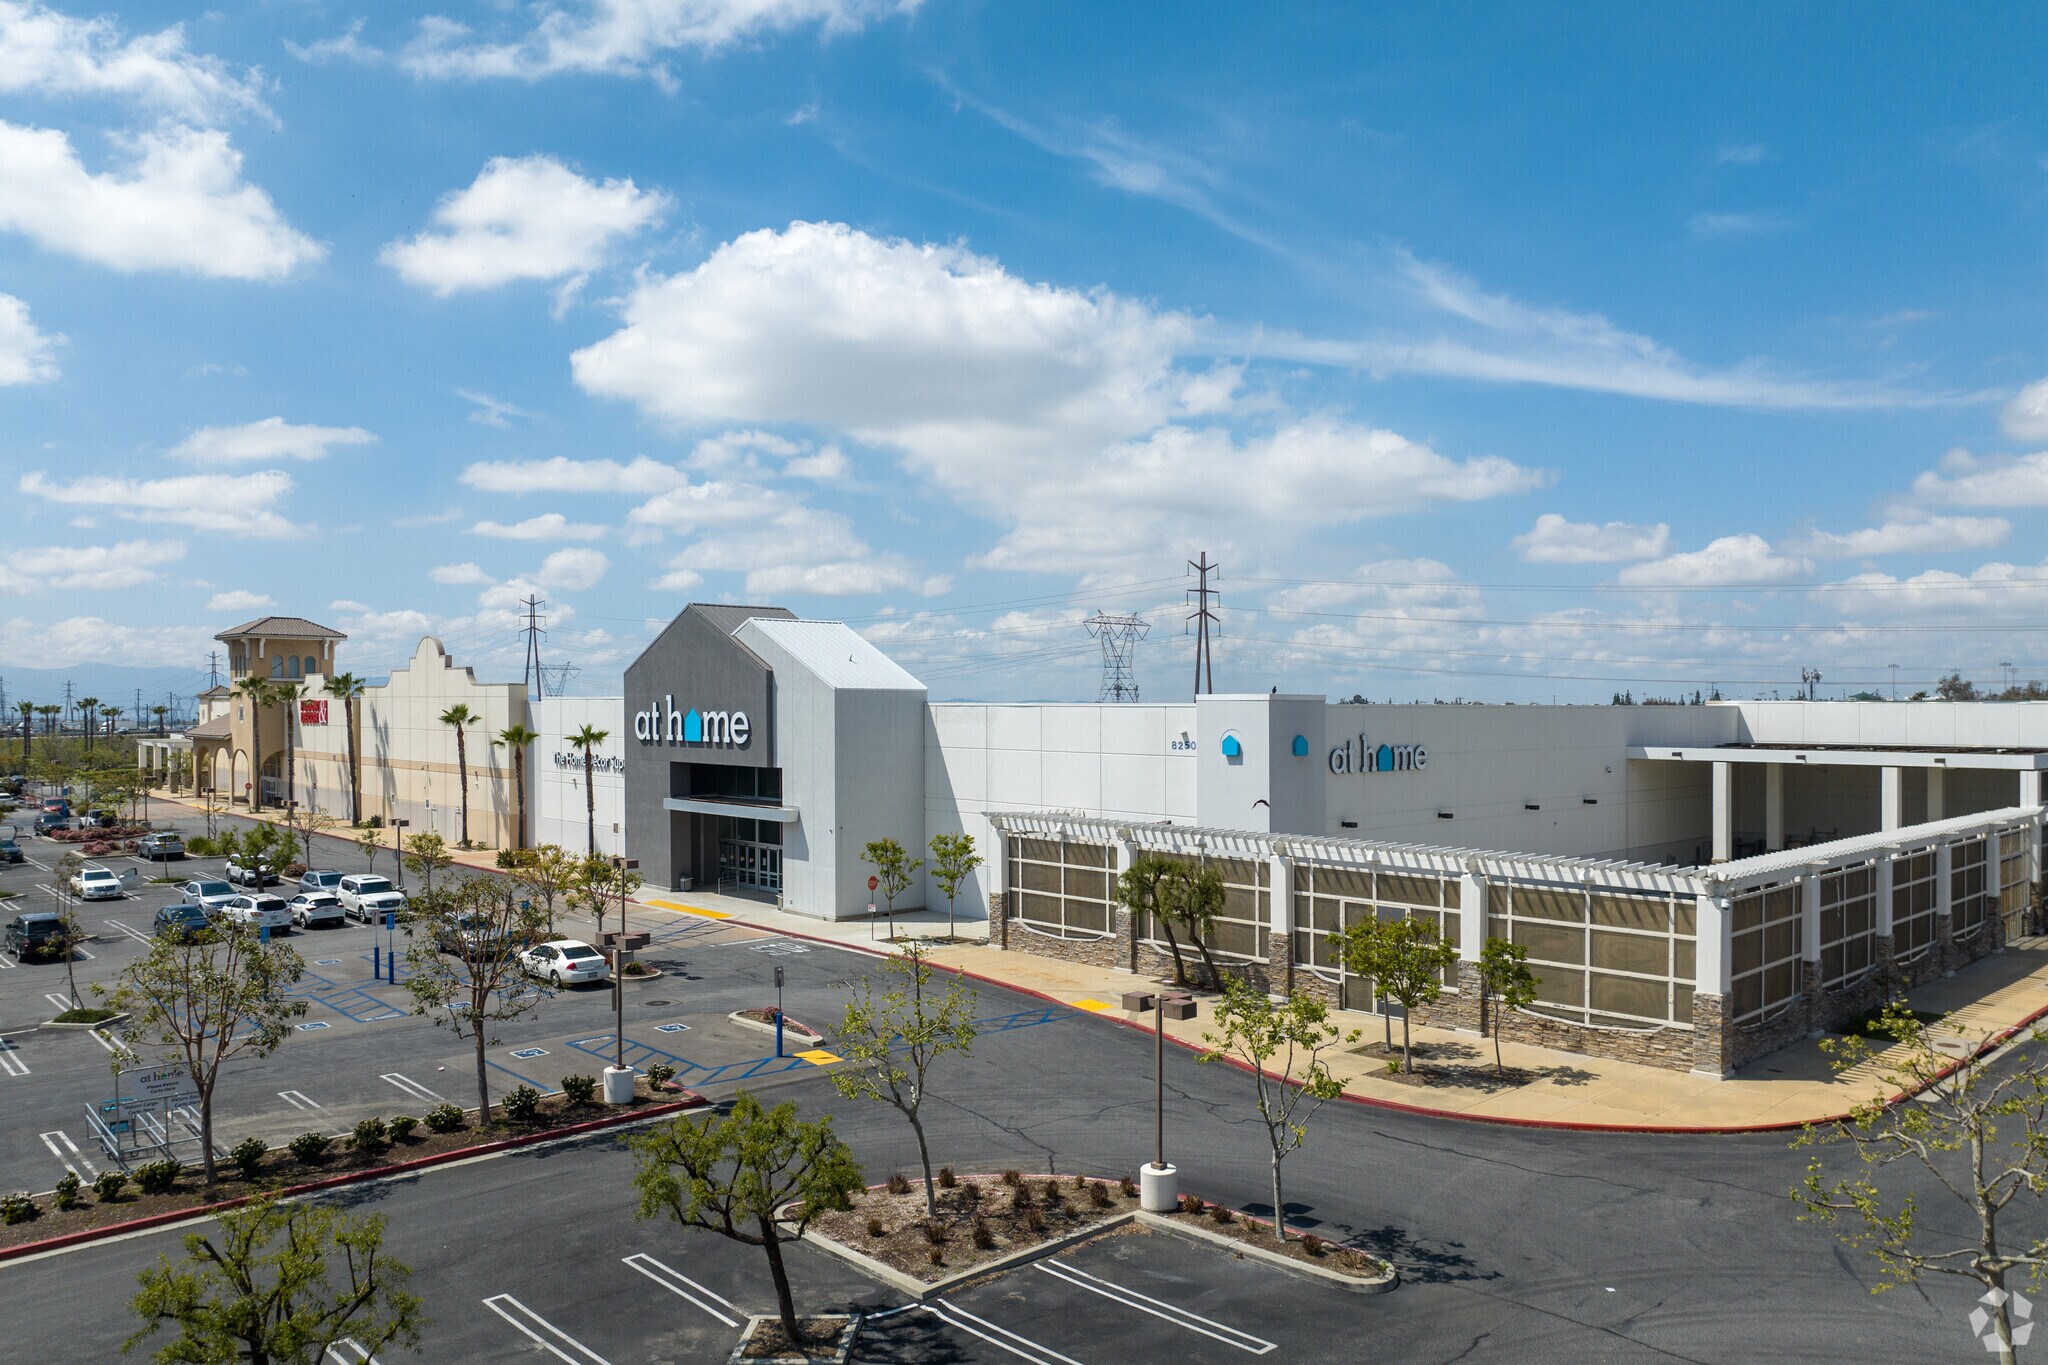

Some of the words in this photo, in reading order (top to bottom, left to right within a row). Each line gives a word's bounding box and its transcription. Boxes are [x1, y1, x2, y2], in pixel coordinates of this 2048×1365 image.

[635, 702, 659, 741] at
[1171, 740, 1197, 751] 8250
[552, 751, 566, 766] The
[567, 752, 586, 767] Home
[611, 755, 625, 771] Sup
[1330, 741, 1356, 775] at
[140, 1074, 151, 1083] at
